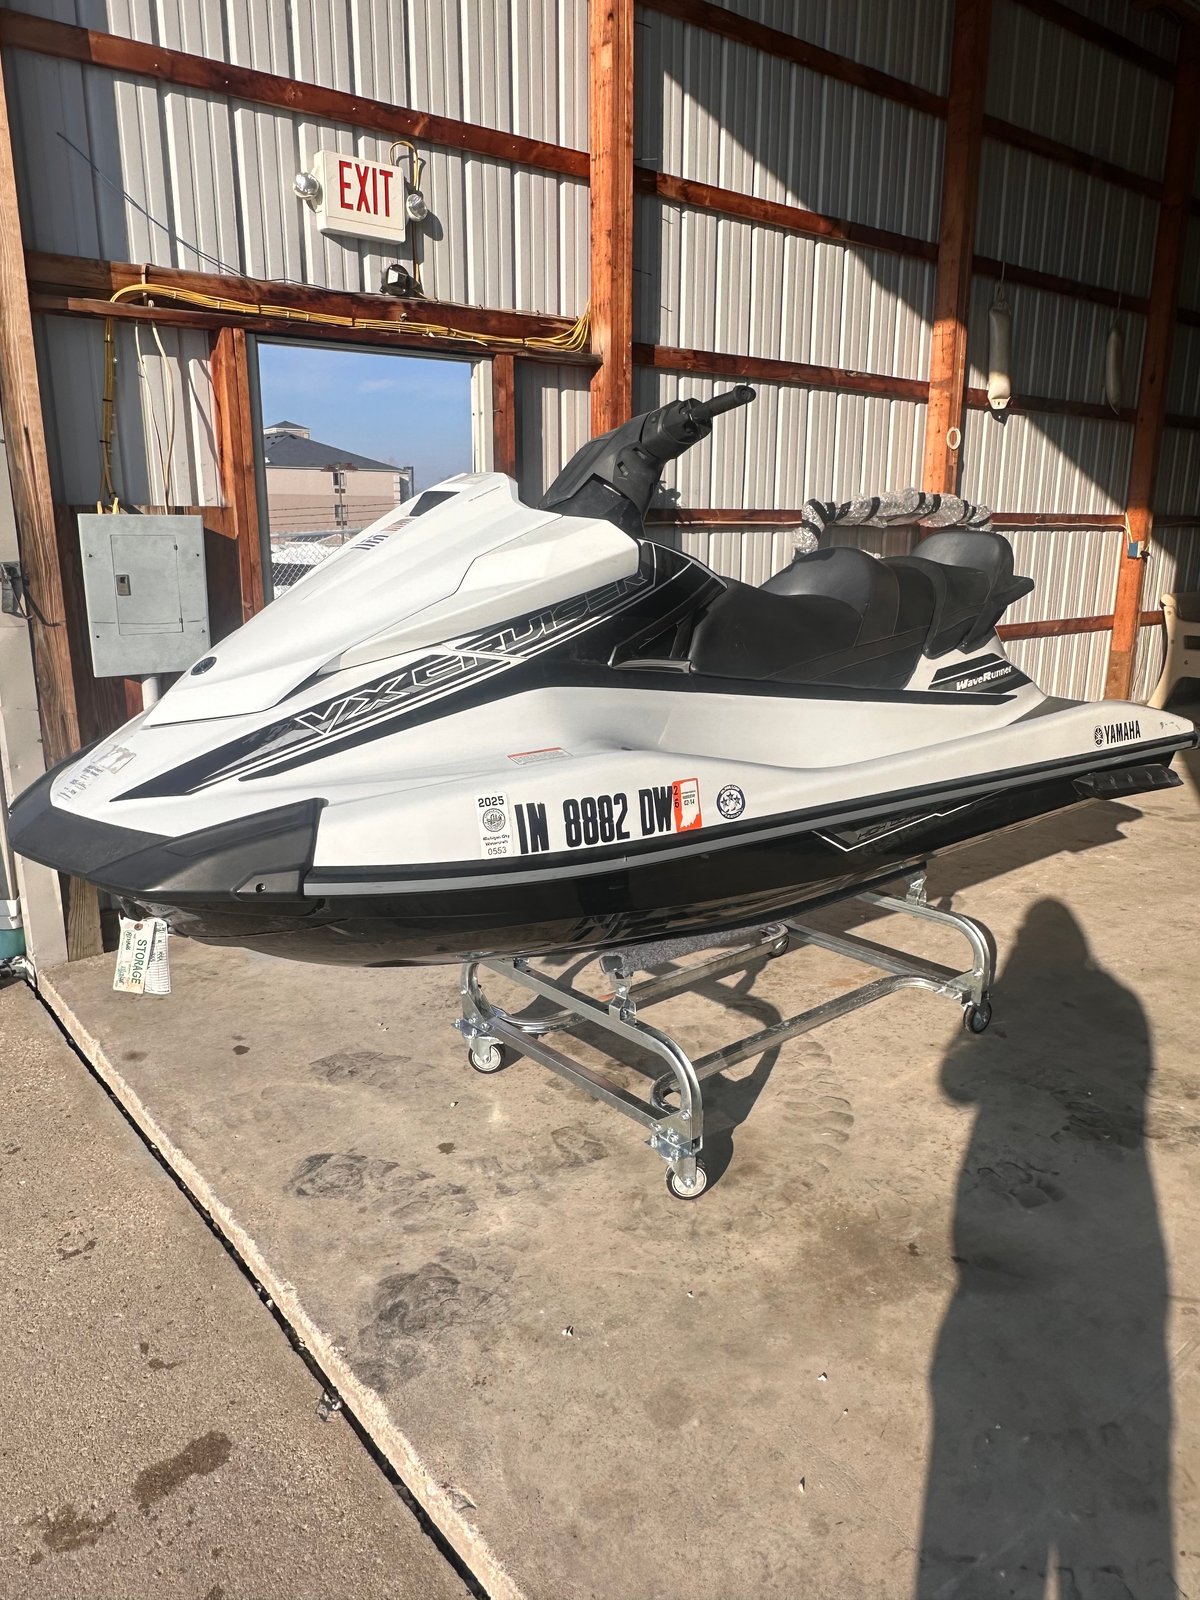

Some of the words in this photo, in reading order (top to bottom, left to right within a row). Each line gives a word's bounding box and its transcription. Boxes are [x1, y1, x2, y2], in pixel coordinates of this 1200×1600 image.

[338, 160, 393, 217] EXIT
[956, 665, 1013, 691] WaveRunner
[295, 672, 412, 735] VX
[1103, 720, 1141, 744] YAMAHA
[478, 795, 505, 807] 2025
[514, 802, 550, 854] IN
[562, 792, 630, 847] 8882
[638, 786, 672, 835] DW
[487, 846, 507, 856] 0553
[131, 939, 147, 984] STORAGE
